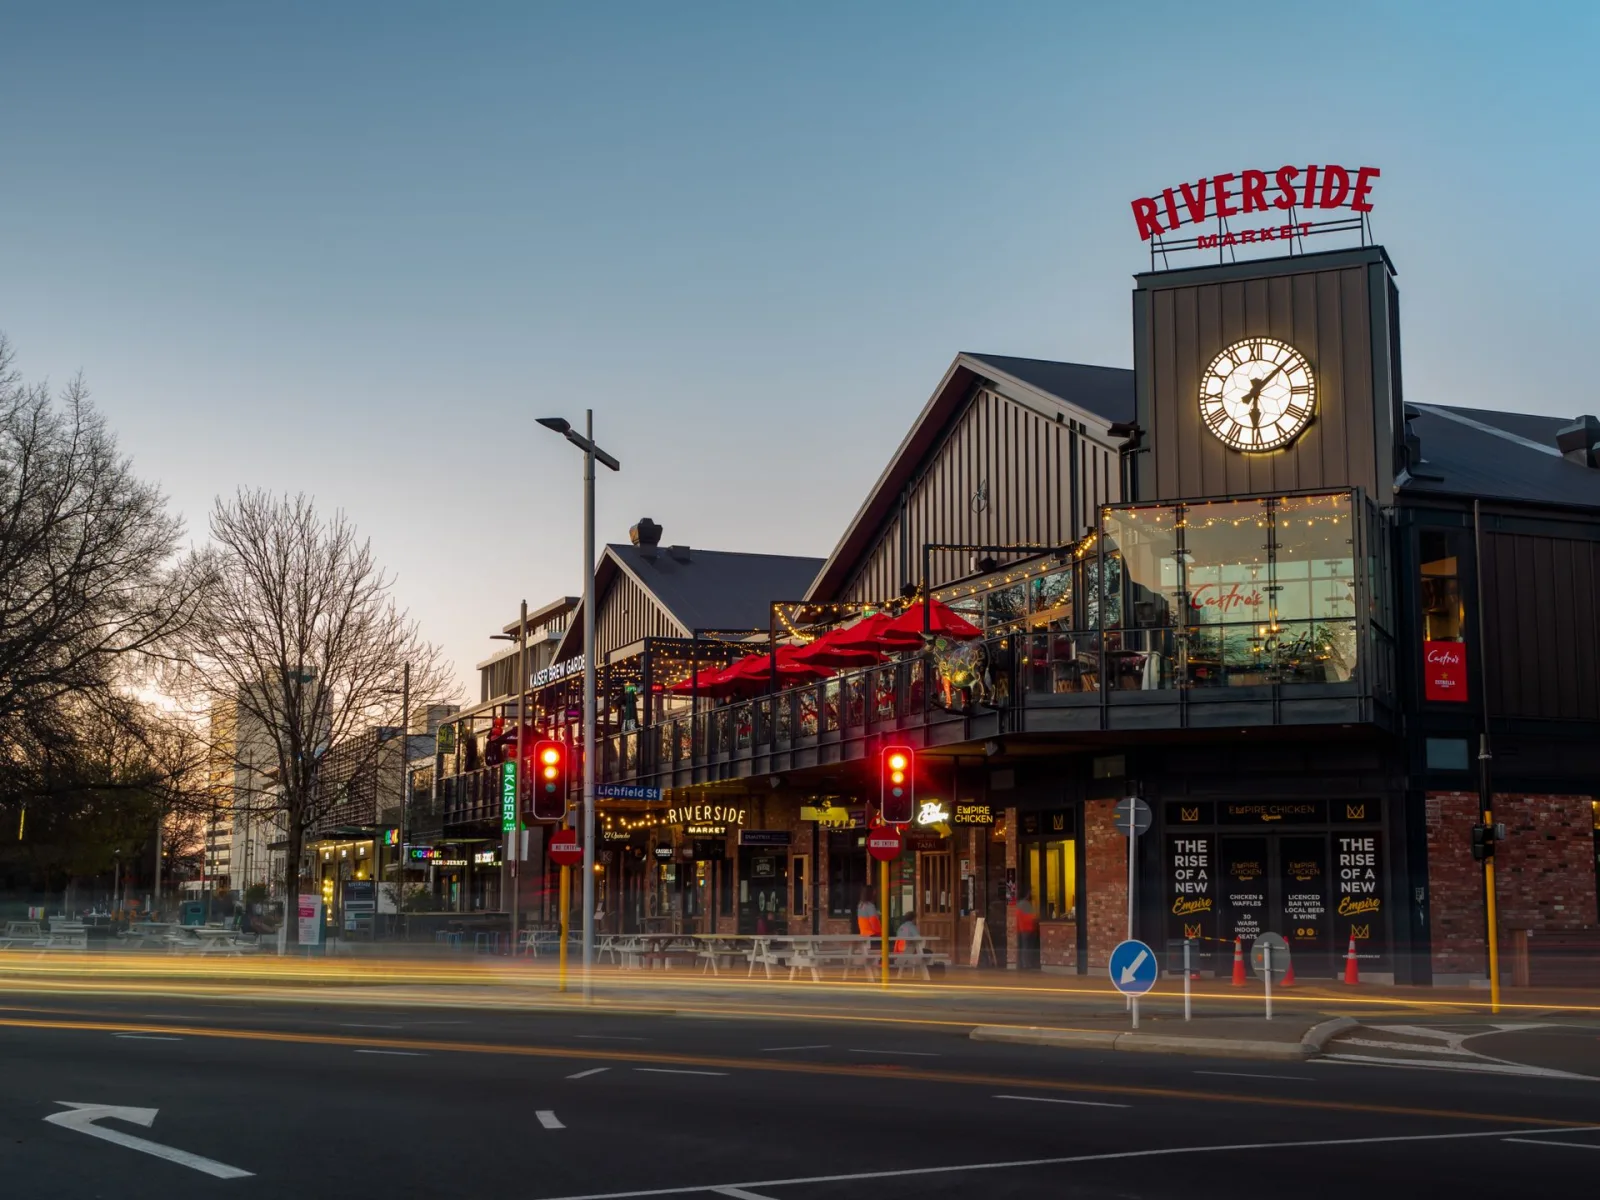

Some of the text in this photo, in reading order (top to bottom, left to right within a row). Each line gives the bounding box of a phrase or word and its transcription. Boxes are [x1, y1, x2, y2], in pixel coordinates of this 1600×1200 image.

[1130, 164, 1381, 241] RIVERSIDE
[1197, 221, 1313, 250] MARKET
[1190, 583, 1264, 613] Castro's
[1427, 649, 1460, 666] Castro's
[529, 653, 585, 689] KAISER BREW GARDE
[503, 774, 515, 820] KAISER
[598, 785, 657, 799] Lichfield St
[668, 805, 746, 825] RIVERSIDE
[957, 805, 991, 815] EMPIRE
[1228, 804, 1315, 815] EMPIRE CHICKEN
[954, 814, 994, 824] CHICKEN
[687, 827, 726, 835] MARKET
[1174, 839, 1208, 853] THE
[1339, 837, 1375, 852] THE
[1174, 855, 1208, 867] RISE
[1339, 854, 1375, 866] RISE
[1175, 869, 1208, 880] OF A
[1230, 868, 1262, 876] CHICKEN
[1287, 868, 1320, 876] CHICKEN
[1340, 869, 1376, 880] OF A
[1175, 882, 1208, 893] NEW
[1340, 882, 1375, 893] NEW
[1171, 895, 1213, 915] Empire
[1337, 895, 1381, 915] Empire
